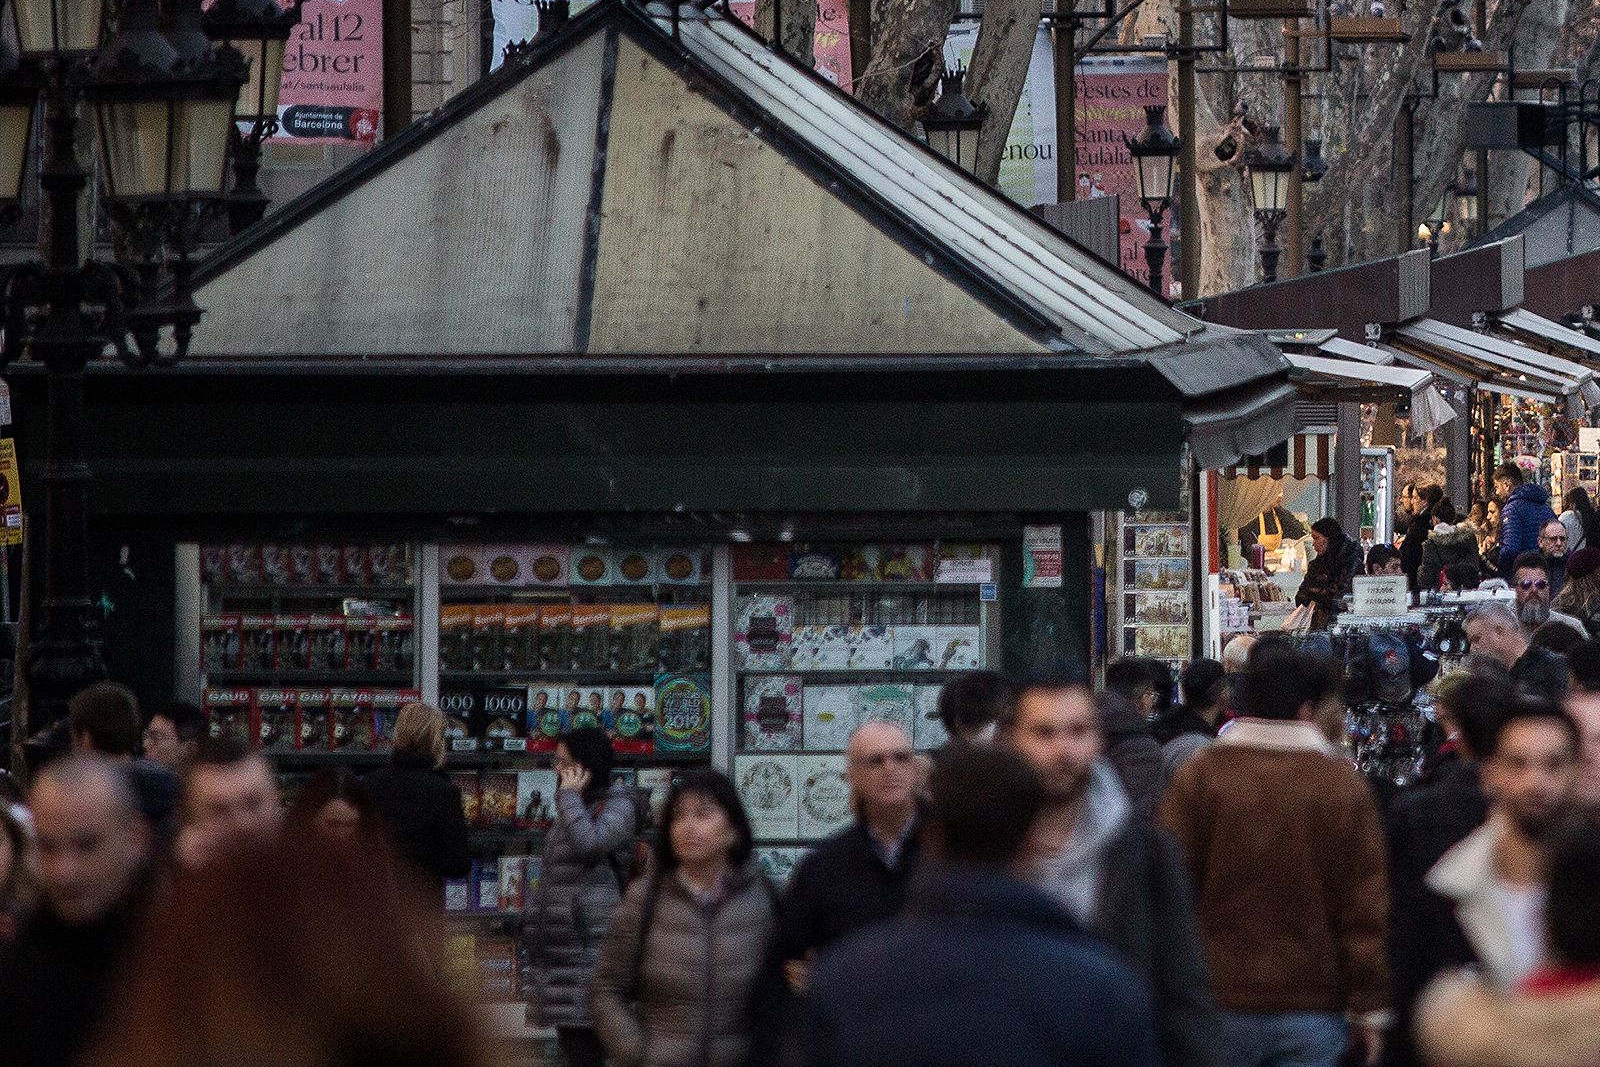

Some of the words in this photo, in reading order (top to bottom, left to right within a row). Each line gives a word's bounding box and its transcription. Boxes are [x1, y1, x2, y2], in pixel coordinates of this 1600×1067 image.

[300, 14, 323, 41] al
[333, 13, 364, 41] 12
[281, 44, 365, 73] ebrer
[1137, 79, 1160, 98] de
[294, 112, 332, 120] Ajuntament
[294, 120, 343, 130] Barcelona
[1000, 144, 1052, 160] enou
[208, 691, 249, 702] GAUD
[301, 691, 329, 702] GAU
[441, 695, 474, 710] 000
[484, 695, 522, 711] 1000
[665, 714, 701, 729] 2019
